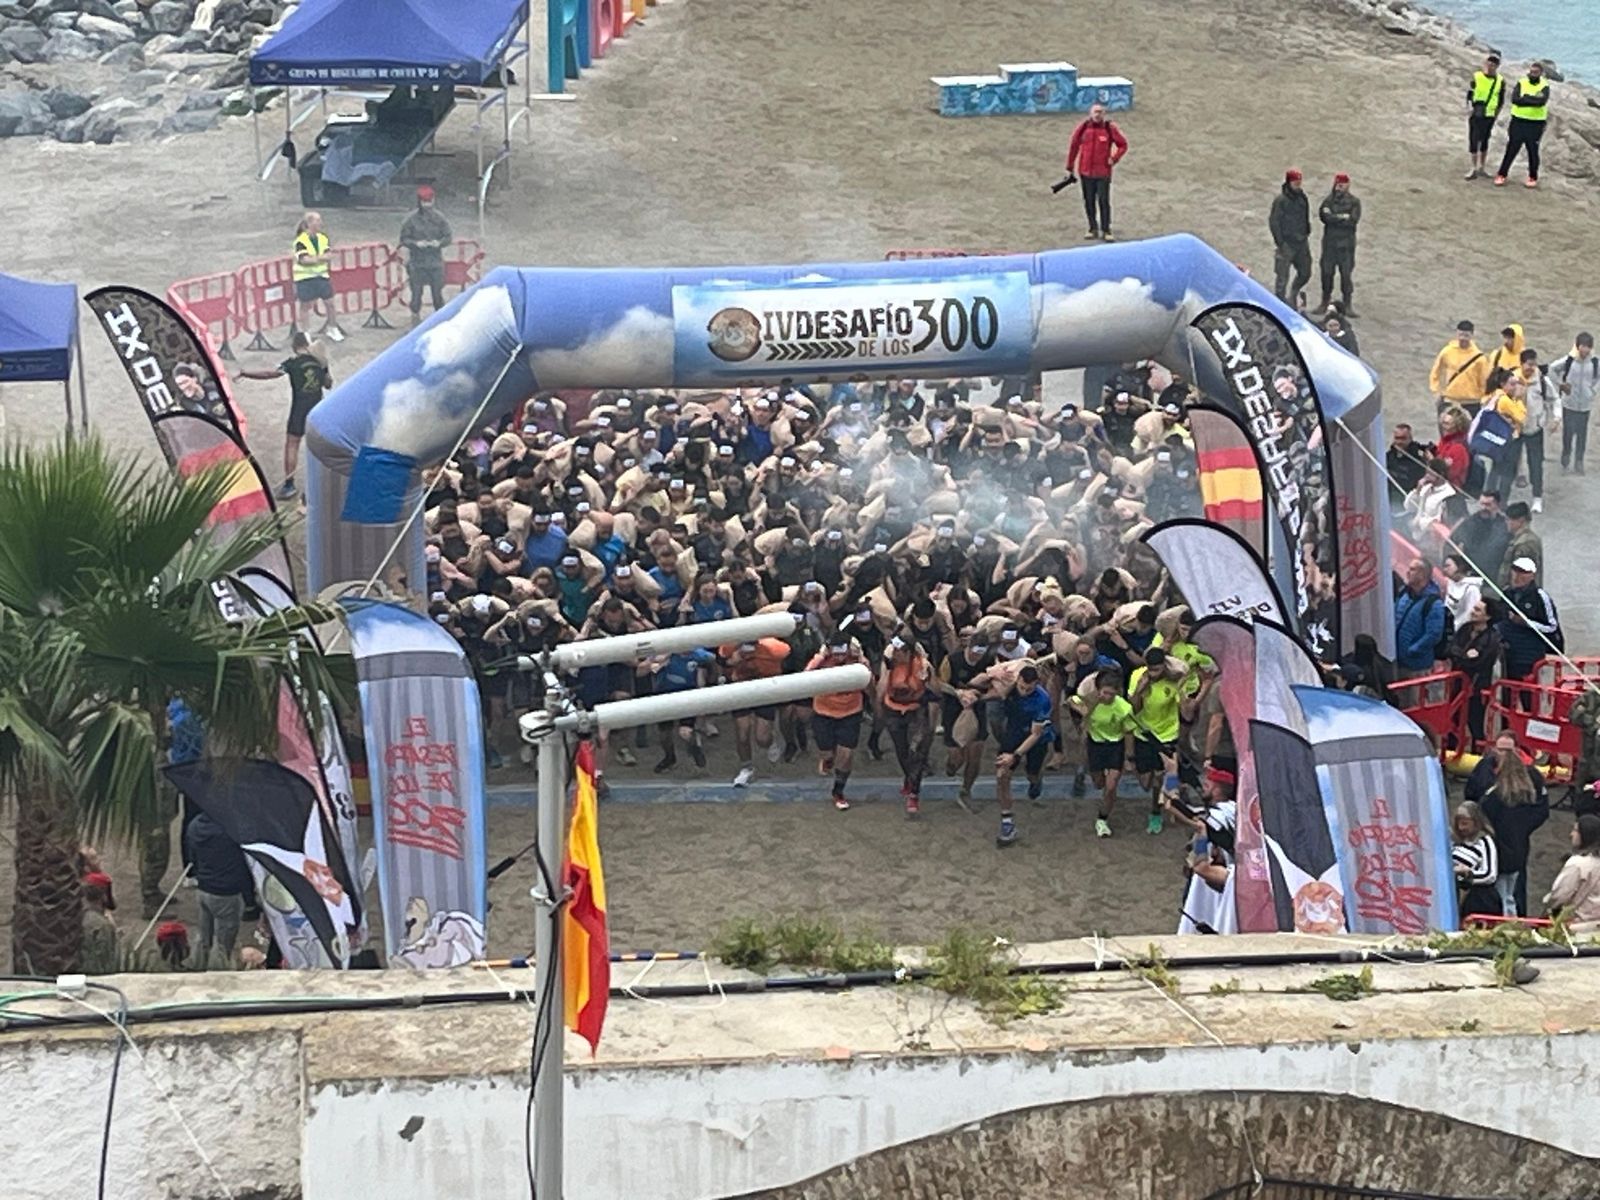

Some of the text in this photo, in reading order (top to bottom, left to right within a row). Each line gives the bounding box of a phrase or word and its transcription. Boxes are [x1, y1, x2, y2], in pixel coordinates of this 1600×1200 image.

[104, 302, 151, 360] IX
[857, 337, 911, 358] DE LOS
[912, 295, 1000, 353] 300
